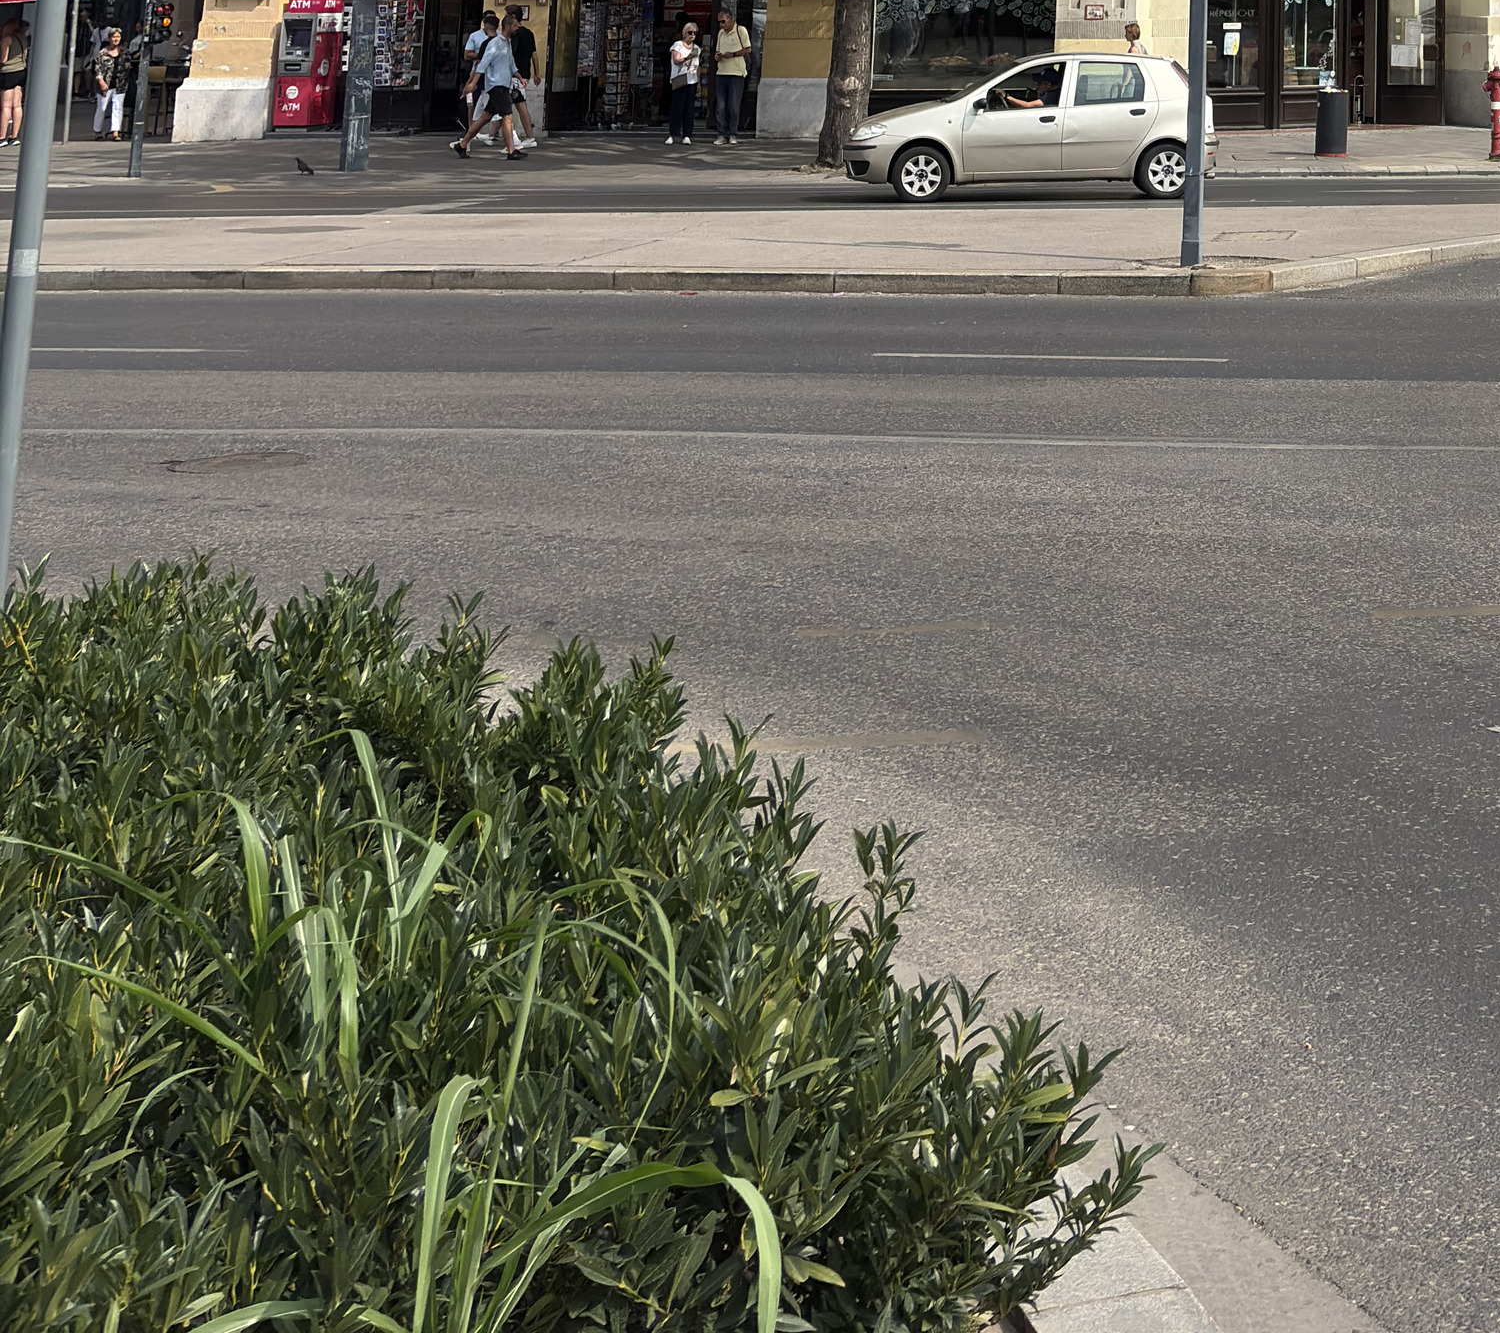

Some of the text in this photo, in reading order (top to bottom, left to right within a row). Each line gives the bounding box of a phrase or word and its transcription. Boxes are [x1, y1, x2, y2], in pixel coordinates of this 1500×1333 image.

[290, 0, 310, 8] ATM
[324, 0, 336, 8] ATM
[281, 103, 301, 111] ATM
